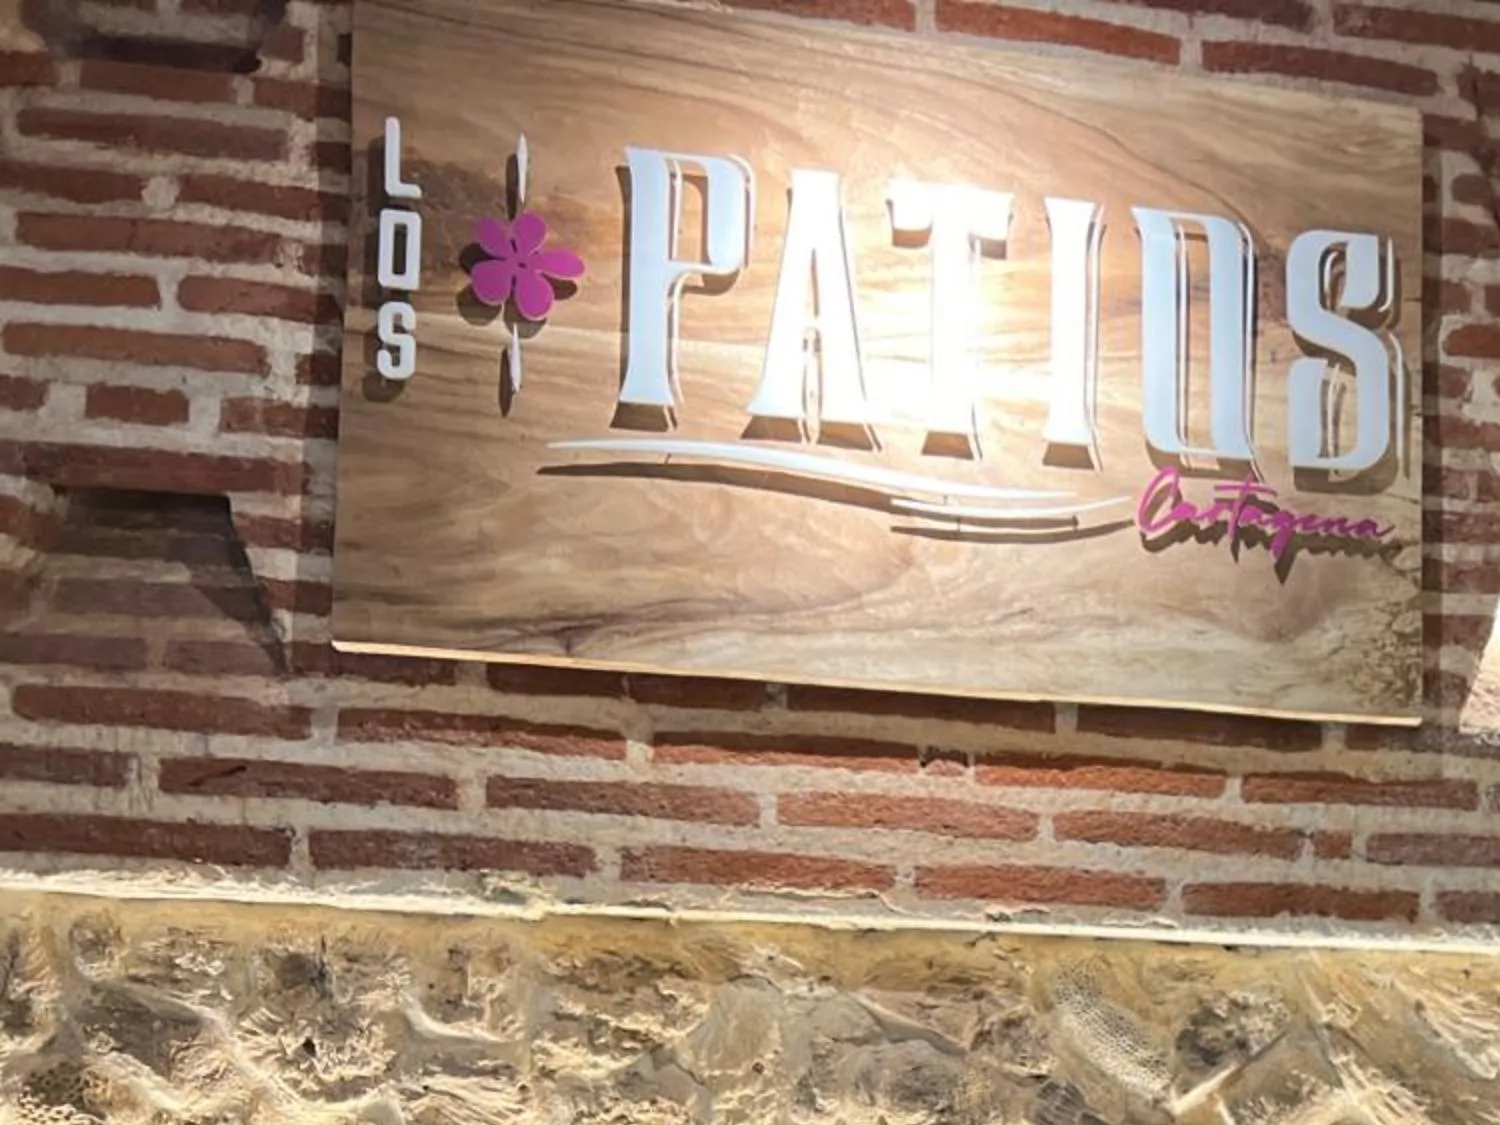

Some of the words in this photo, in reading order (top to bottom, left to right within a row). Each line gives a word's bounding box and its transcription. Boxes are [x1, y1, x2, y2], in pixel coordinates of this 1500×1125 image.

[378, 116, 421, 382] LOS
[617, 144, 1402, 472] PATIOS
[1138, 466, 1397, 561] Cartagena
